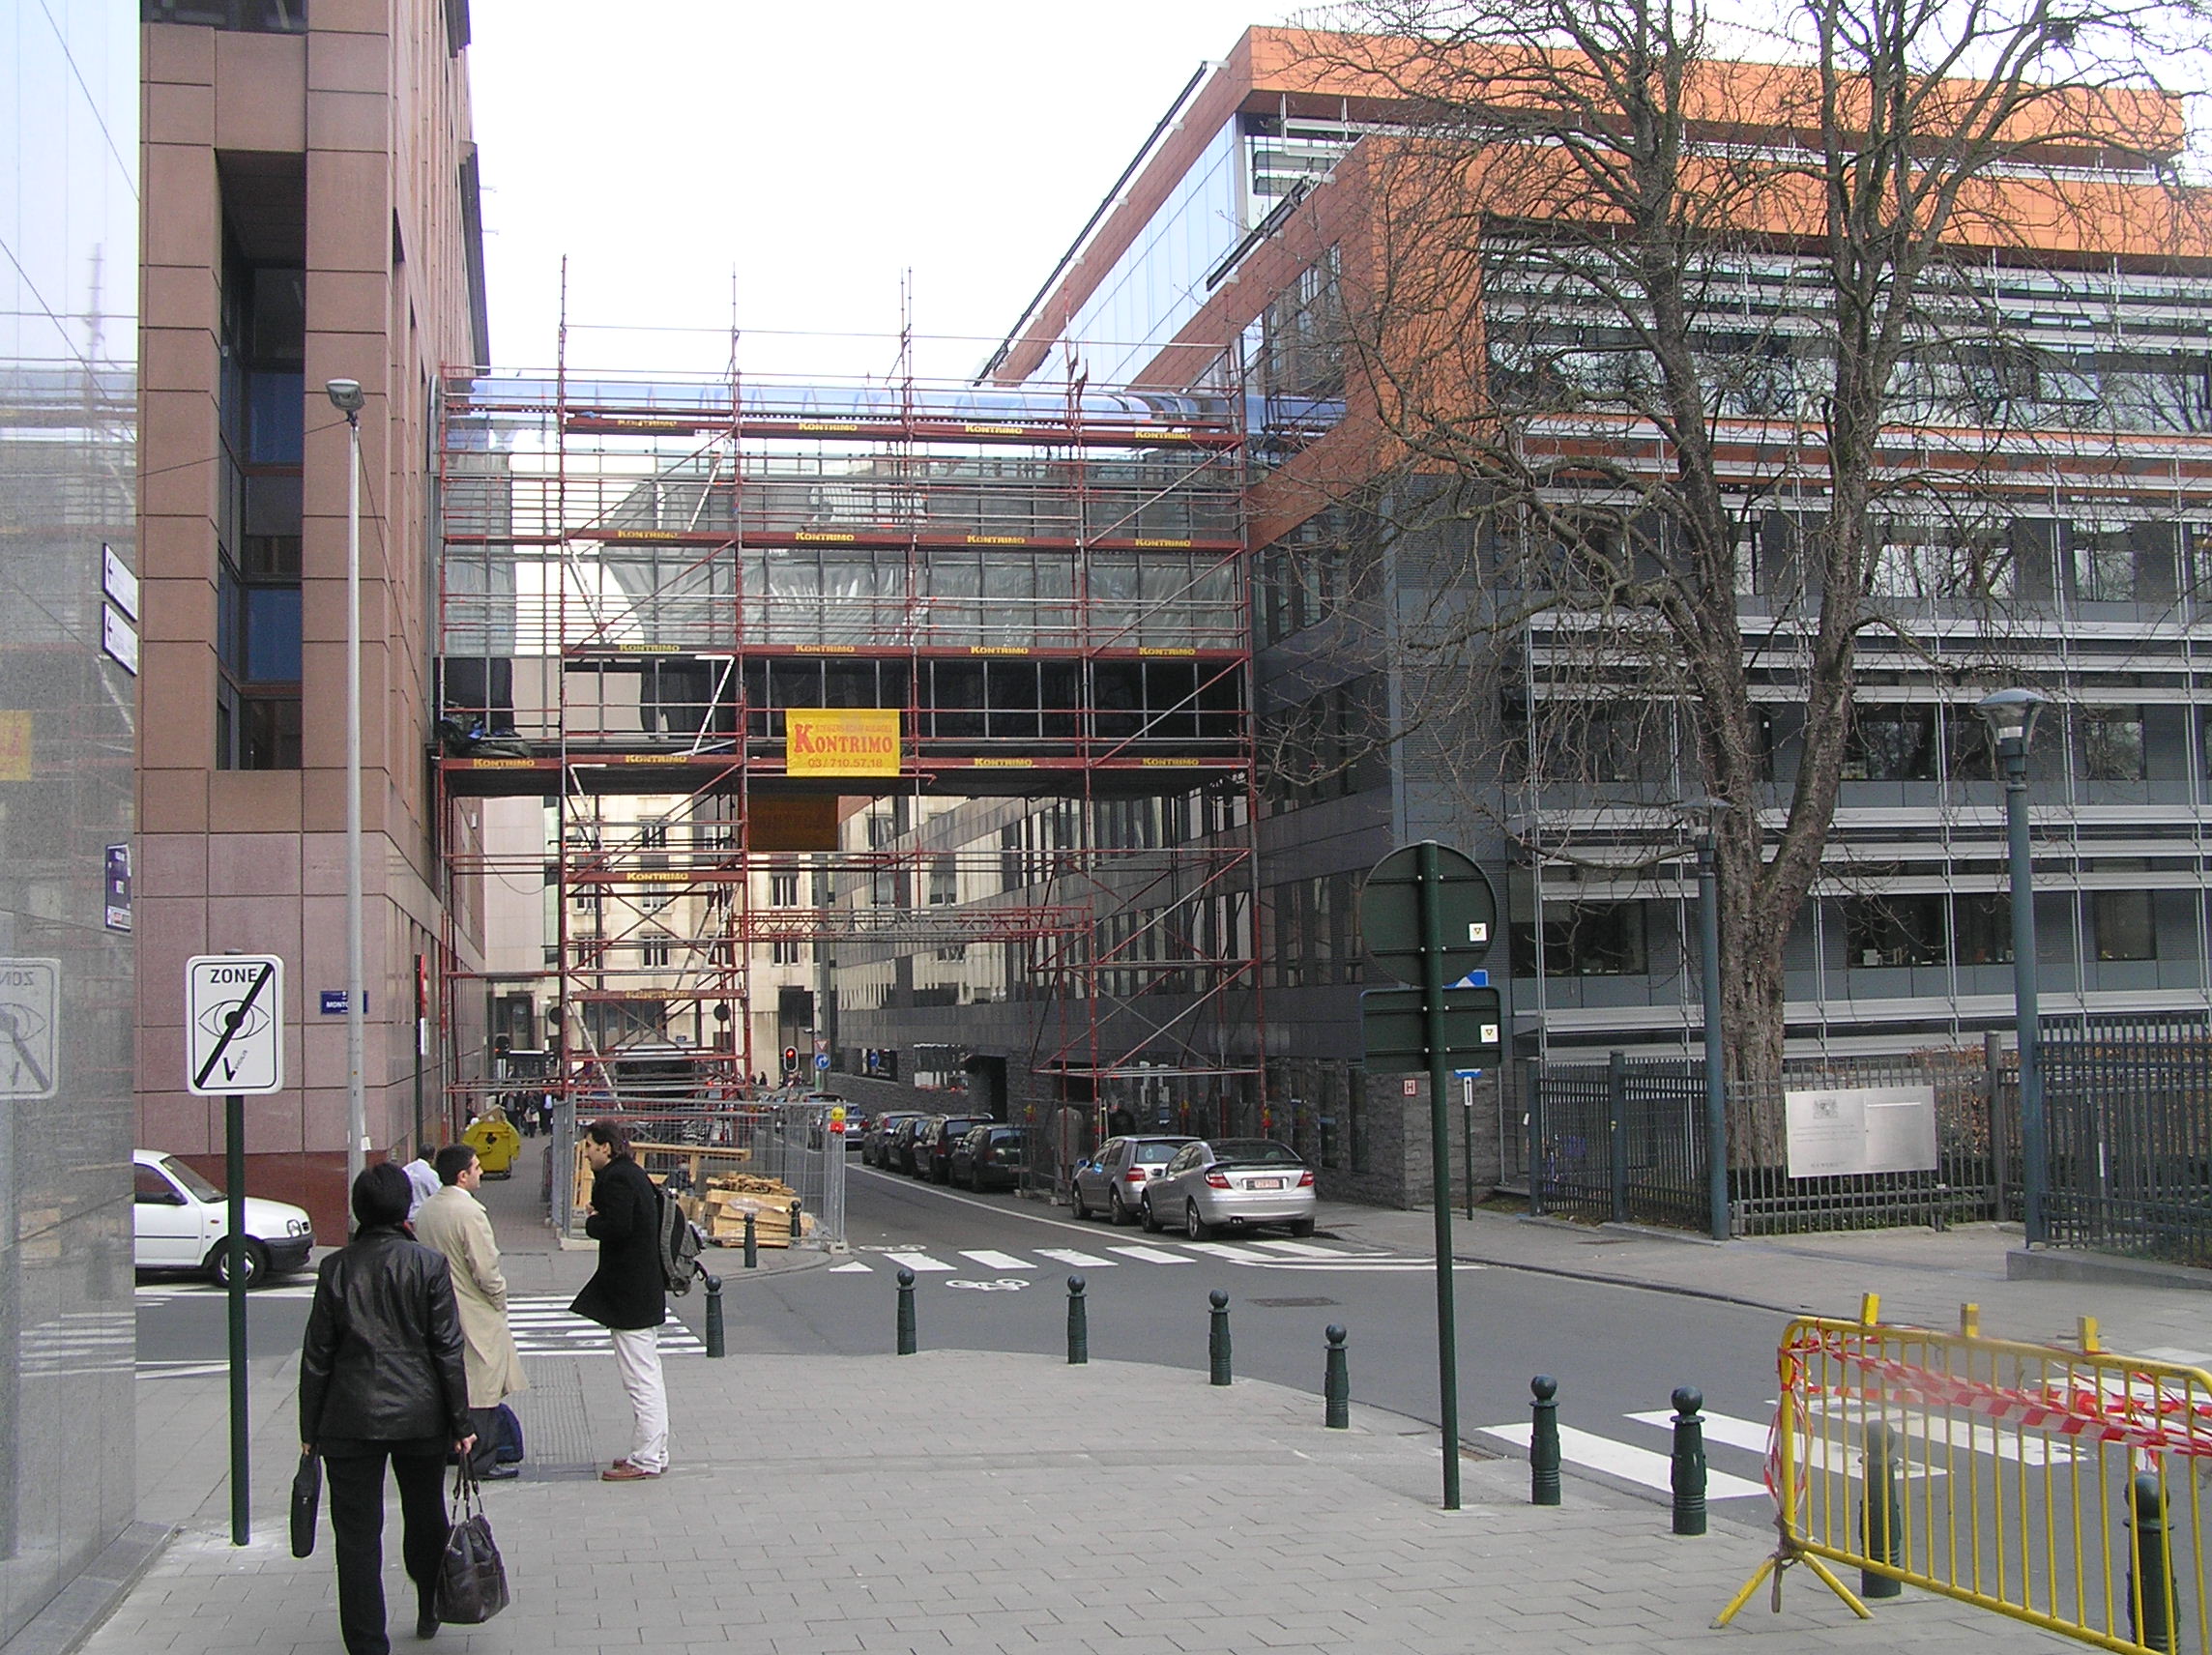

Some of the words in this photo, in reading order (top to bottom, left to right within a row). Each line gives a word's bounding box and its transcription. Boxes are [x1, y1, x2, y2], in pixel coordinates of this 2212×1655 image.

[799, 422, 858, 431] KONTRIMO
[965, 425, 1023, 435] KONTRIMO
[1135, 430, 1191, 439] KONTRIMO
[618, 531, 678, 539] KONTRIMO
[796, 532, 855, 541] KONTRIMO
[967, 536, 1025, 544] KONTRIMO
[1135, 538, 1191, 547] KONTRIMO
[619, 644, 680, 653] KONTRIMO
[795, 644, 855, 653] KONTRIMO
[970, 646, 1029, 654] KONTRIMO
[1139, 647, 1196, 655] KONTRIMO
[794, 723, 892, 753] KONTRIMO
[626, 754, 687, 763] KONTRIMO
[974, 758, 1033, 767] KONTRIMO
[473, 759, 535, 768] KONTRIMO
[626, 872, 688, 881] KONTRIMO
[210, 969, 258, 983] ZONE
